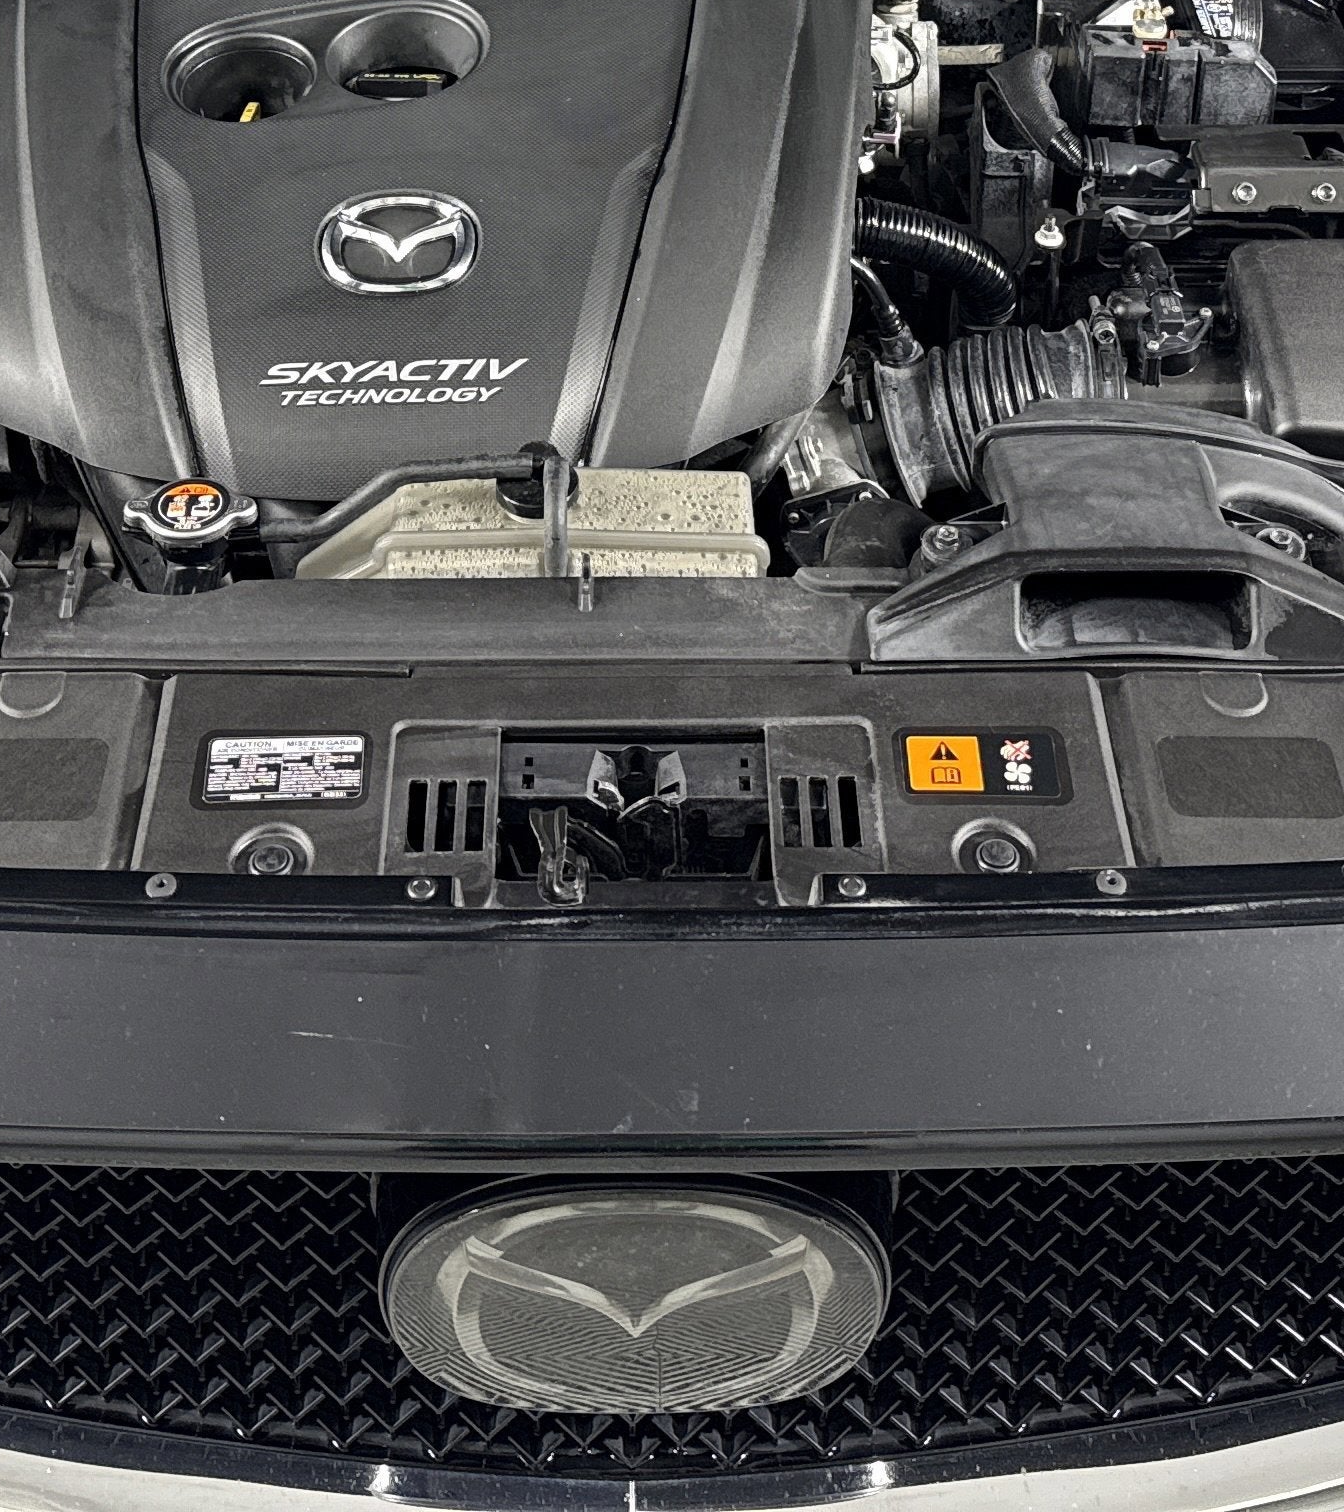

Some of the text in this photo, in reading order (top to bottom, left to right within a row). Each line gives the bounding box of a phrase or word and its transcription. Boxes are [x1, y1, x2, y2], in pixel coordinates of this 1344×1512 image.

[258, 357, 529, 386] SKYACTIV
[280, 386, 504, 407] TECHNOLOGY
[225, 741, 272, 749] CAUTION
